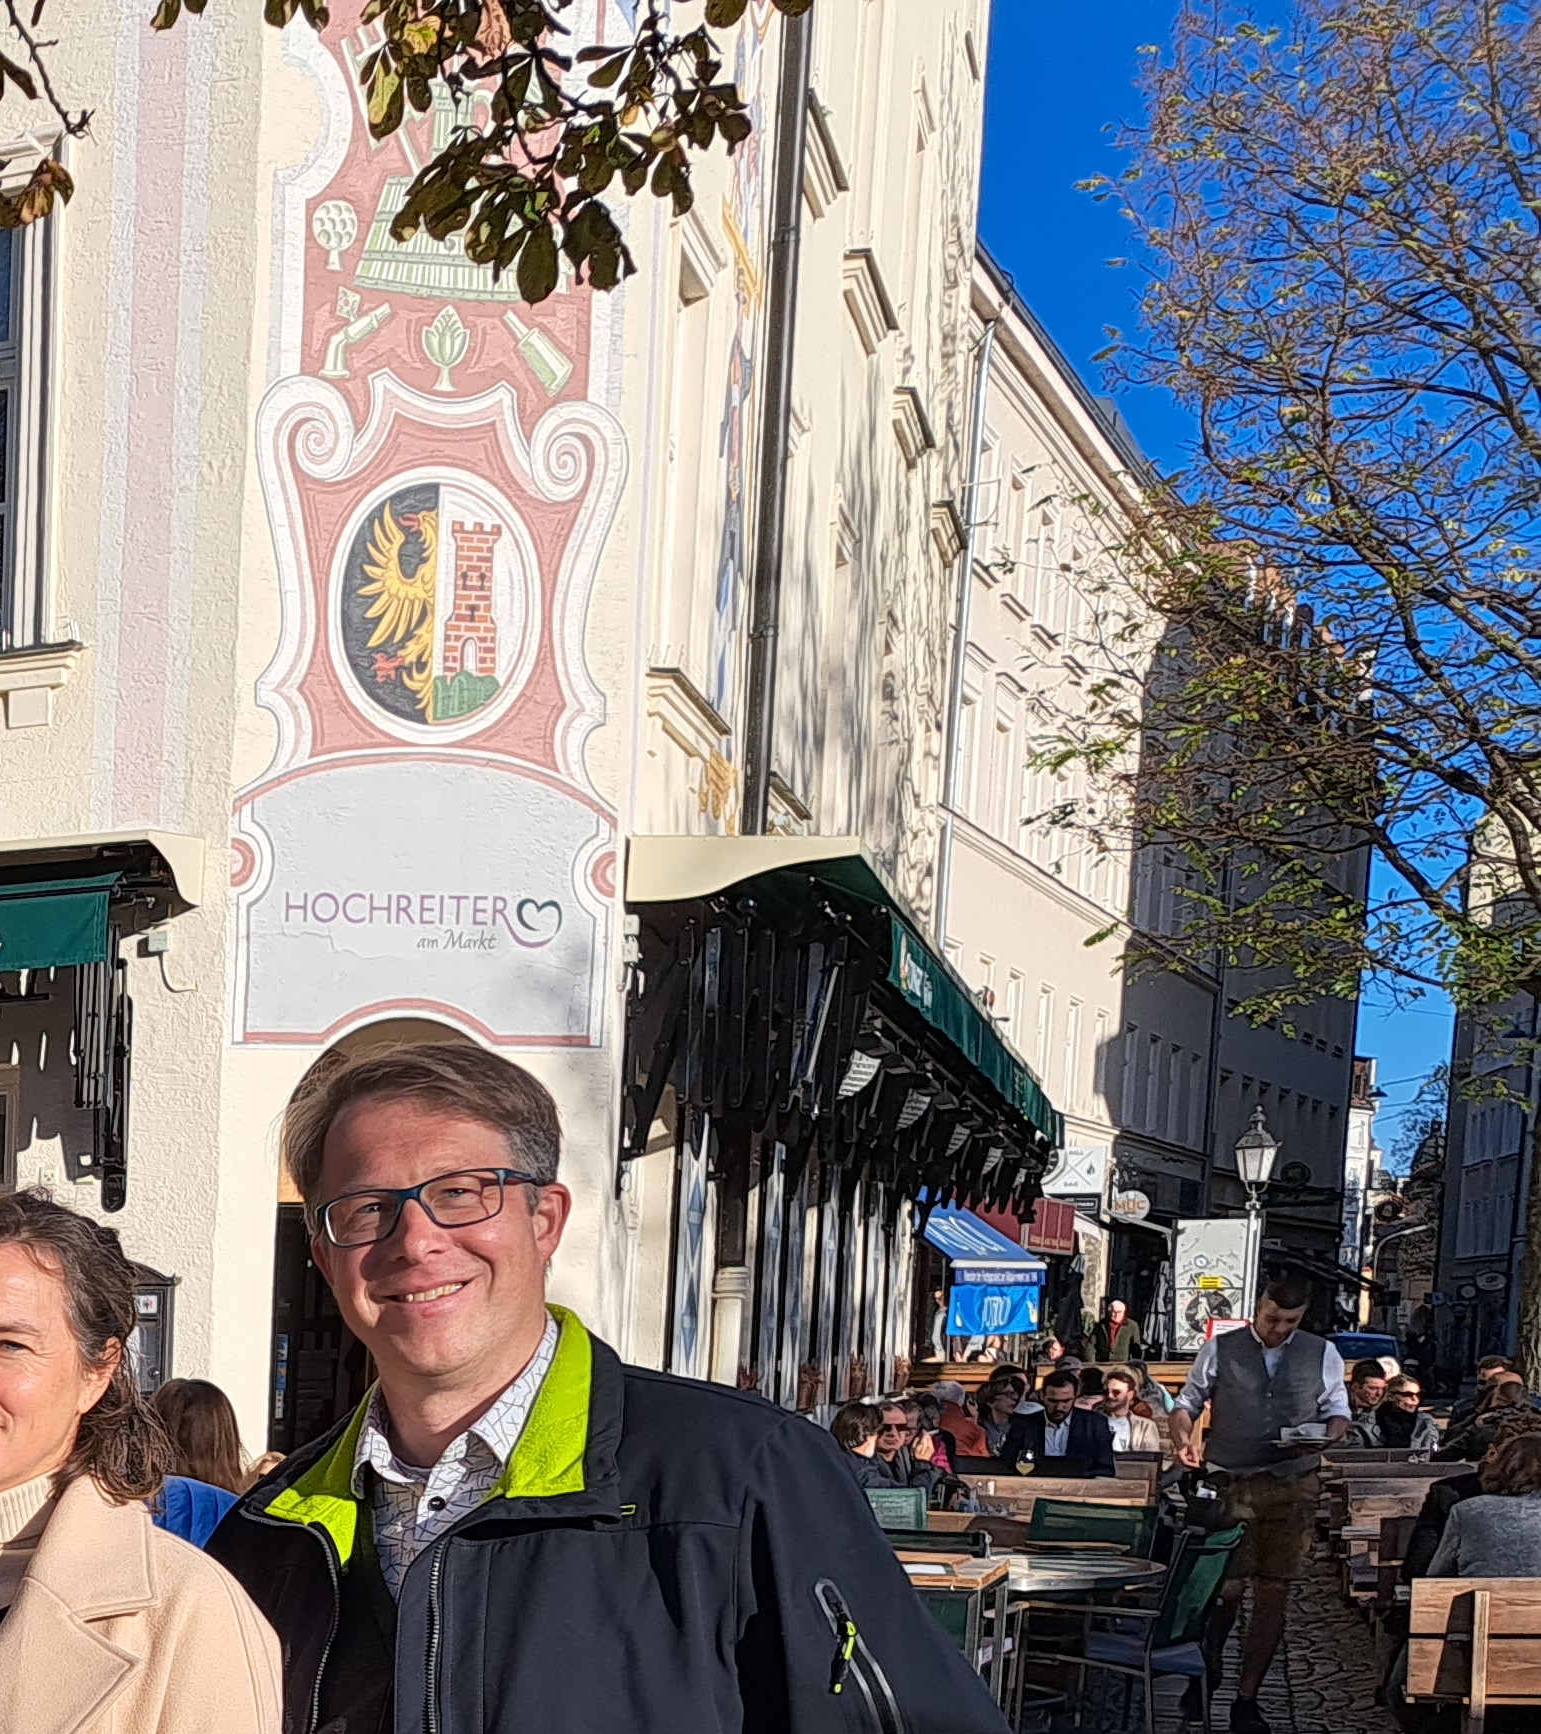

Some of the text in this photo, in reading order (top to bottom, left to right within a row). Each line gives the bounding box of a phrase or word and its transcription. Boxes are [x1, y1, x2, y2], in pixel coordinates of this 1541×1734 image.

[284, 891, 511, 927] HOCHREITER
[417, 928, 497, 950] am Markt
